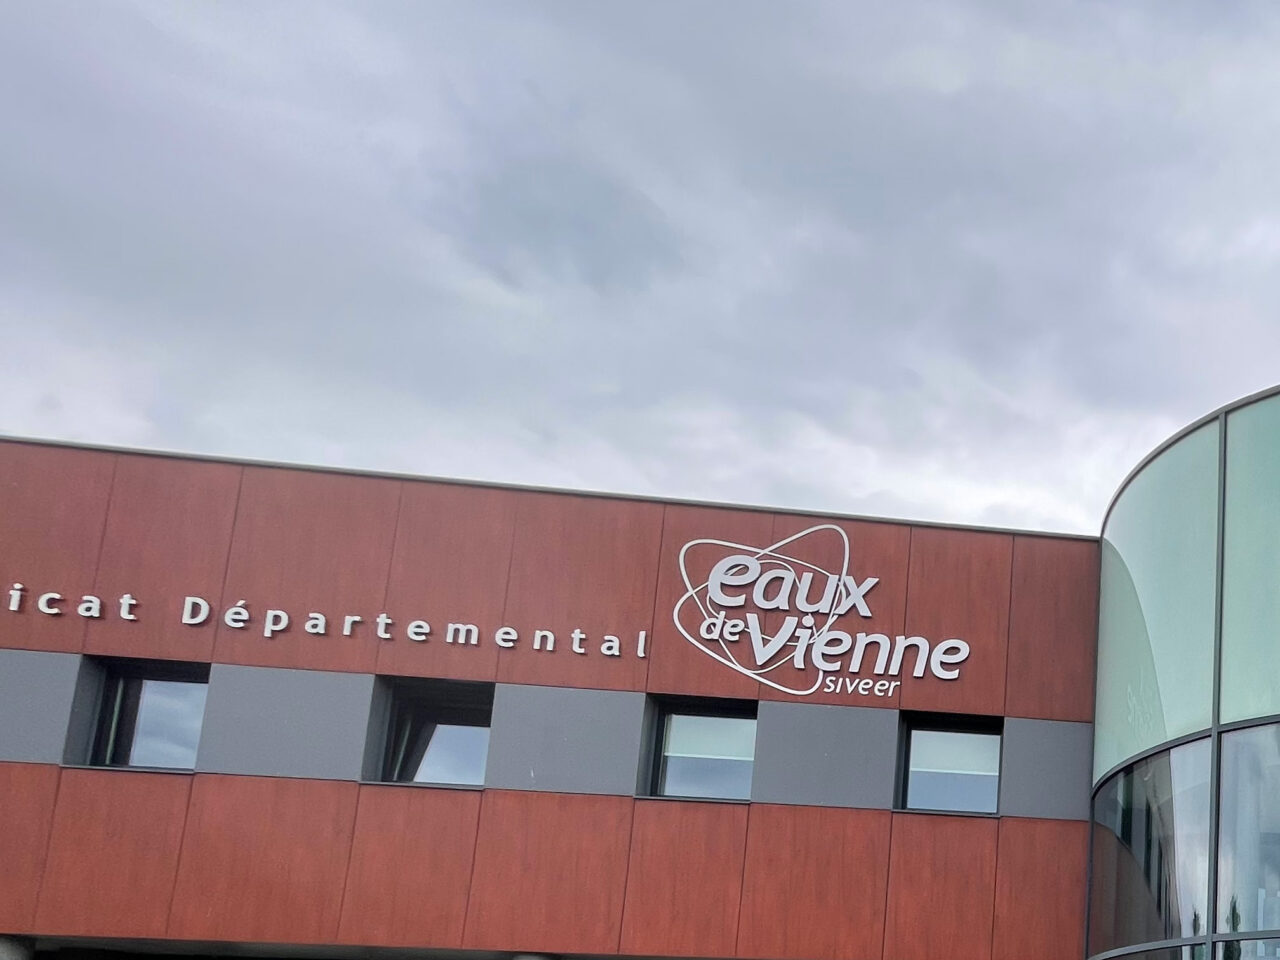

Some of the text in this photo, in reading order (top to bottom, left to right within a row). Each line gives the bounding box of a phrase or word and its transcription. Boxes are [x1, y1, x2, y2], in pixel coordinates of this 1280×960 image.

[9, 583, 646, 658] icat Départemental
[708, 555, 879, 617] eaux
[700, 611, 970, 680] de Vienne
